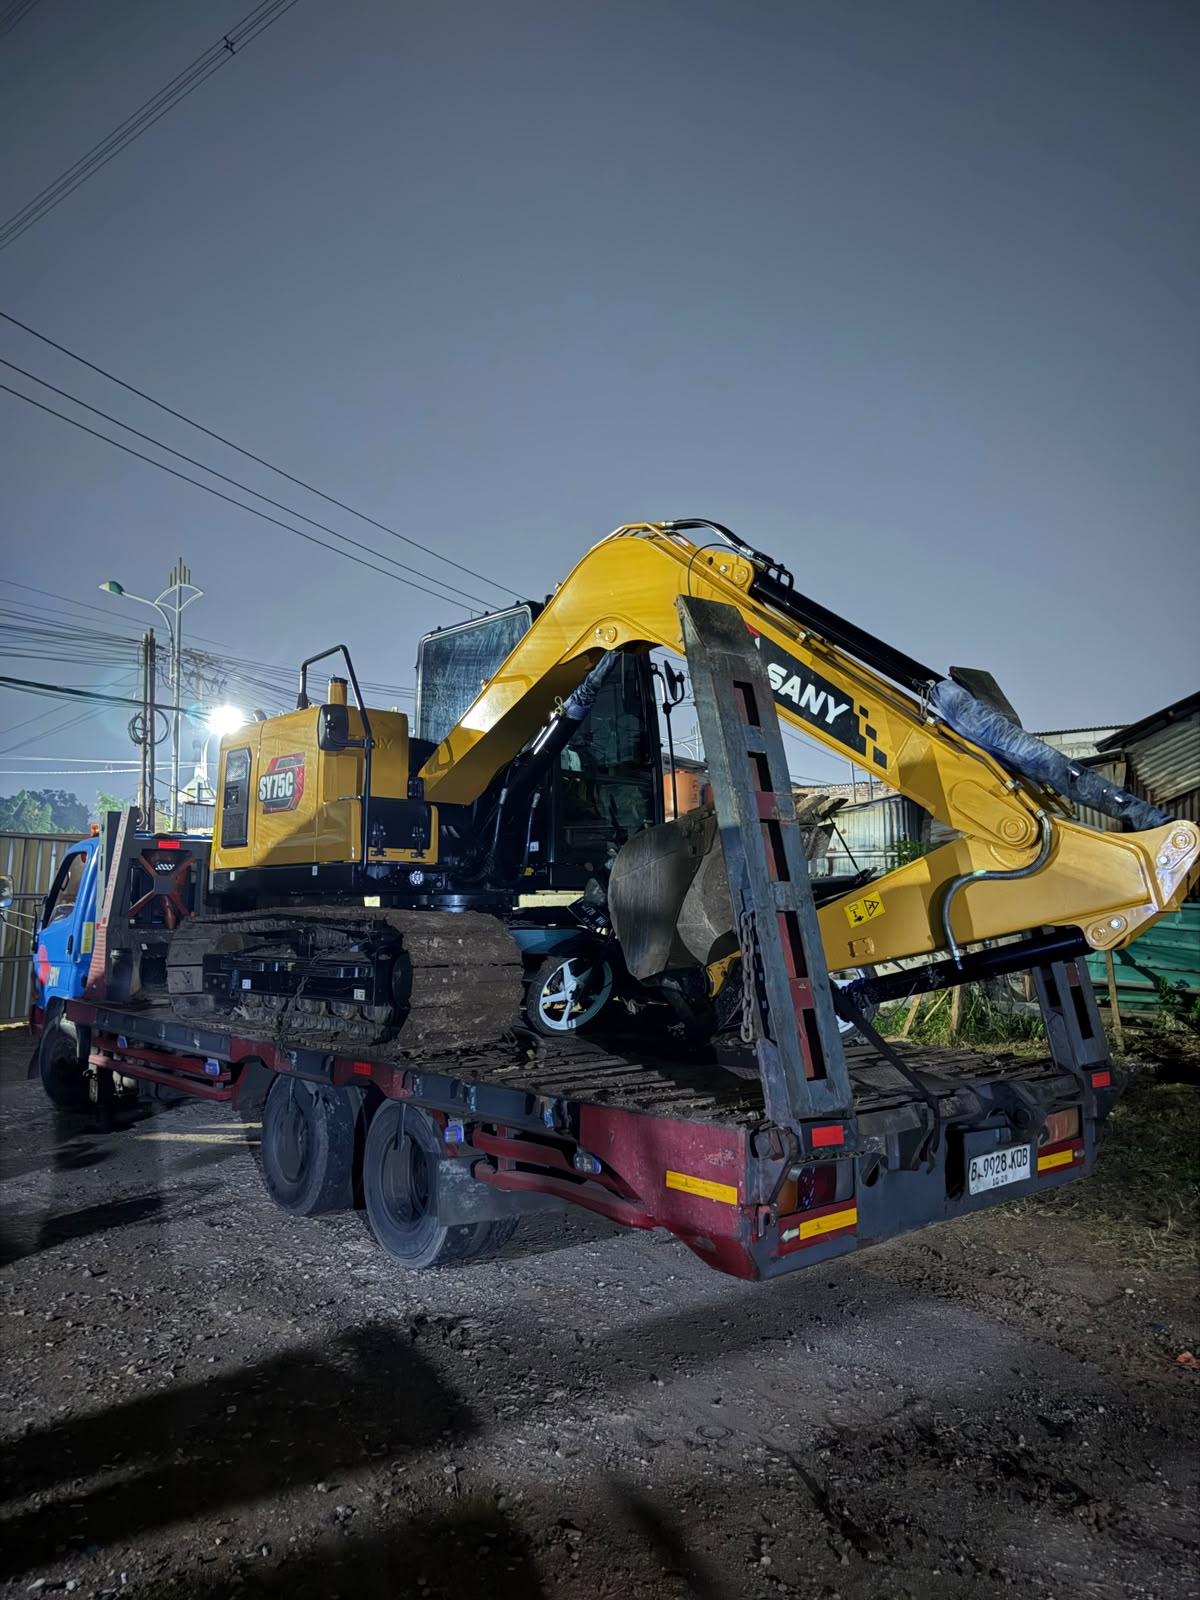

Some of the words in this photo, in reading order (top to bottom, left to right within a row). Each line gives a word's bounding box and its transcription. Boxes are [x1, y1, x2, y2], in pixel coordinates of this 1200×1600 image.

[767, 663, 850, 724] SANY
[259, 771, 294, 801] SY75C
[971, 1162, 978, 1182] B
[983, 1153, 1007, 1178] 9928
[1010, 1148, 1028, 1170] KQB
